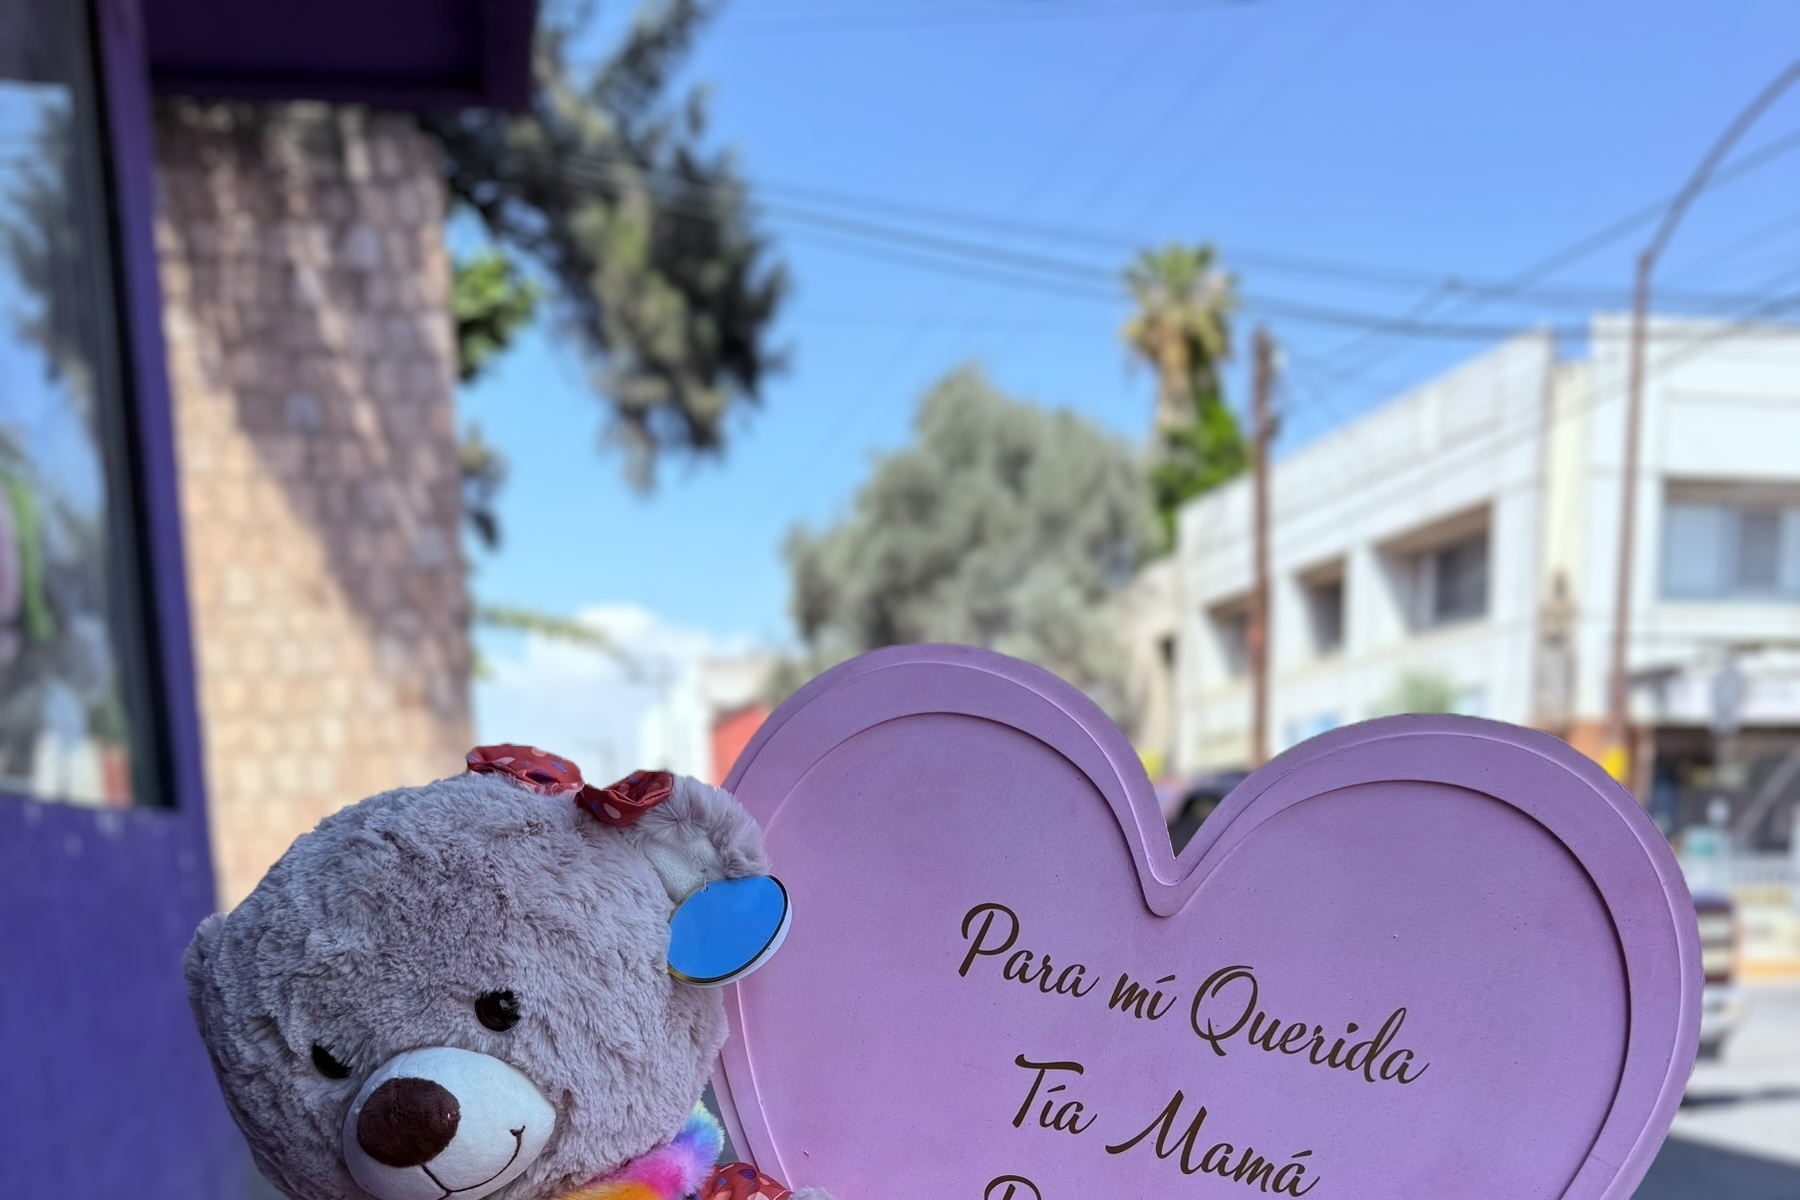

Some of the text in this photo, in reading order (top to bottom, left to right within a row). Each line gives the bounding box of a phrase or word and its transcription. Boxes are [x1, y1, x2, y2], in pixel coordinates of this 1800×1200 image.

[958, 902, 1430, 1084] Para mí Querida
[1012, 1053, 1320, 1198] Tía Mamá
